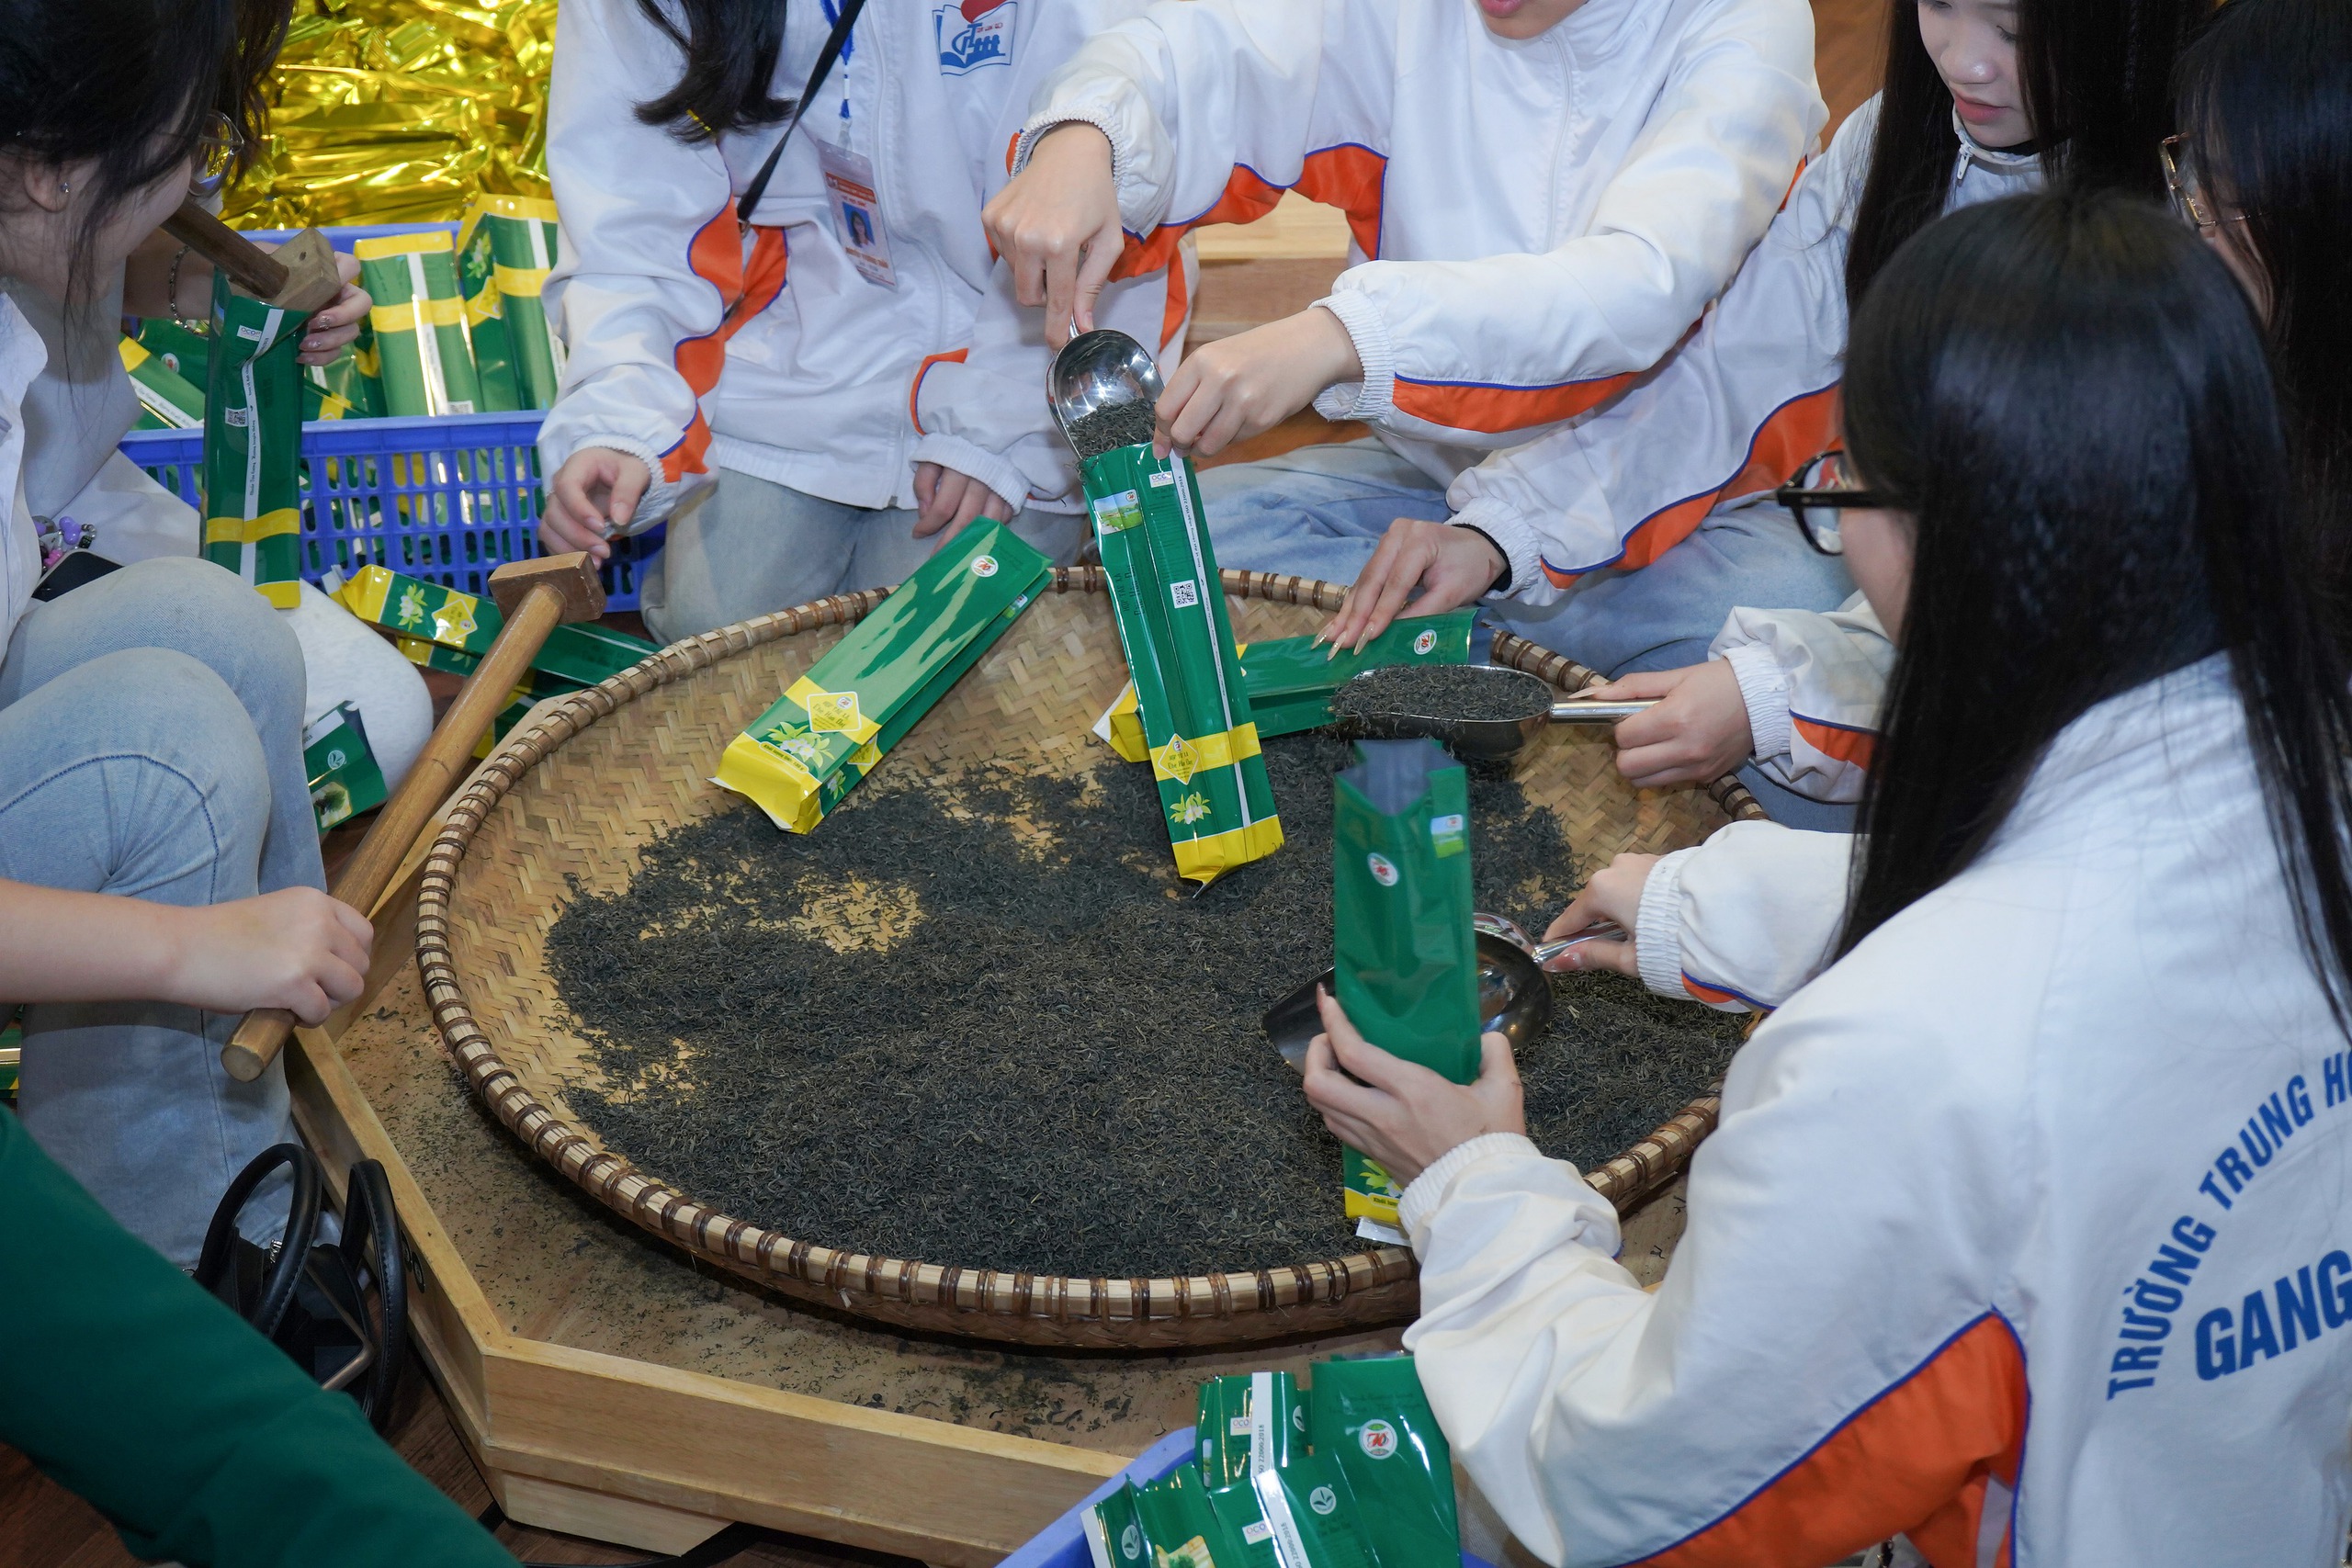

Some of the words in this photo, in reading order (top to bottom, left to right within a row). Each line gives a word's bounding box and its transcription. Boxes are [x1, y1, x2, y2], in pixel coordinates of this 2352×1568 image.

[2107, 1215, 2217, 1401] TRƯỜNG
[2199, 1075, 2314, 1212] TRUNG
[2324, 1049, 2352, 1109] H
[2194, 1250, 2352, 1381] GANG
